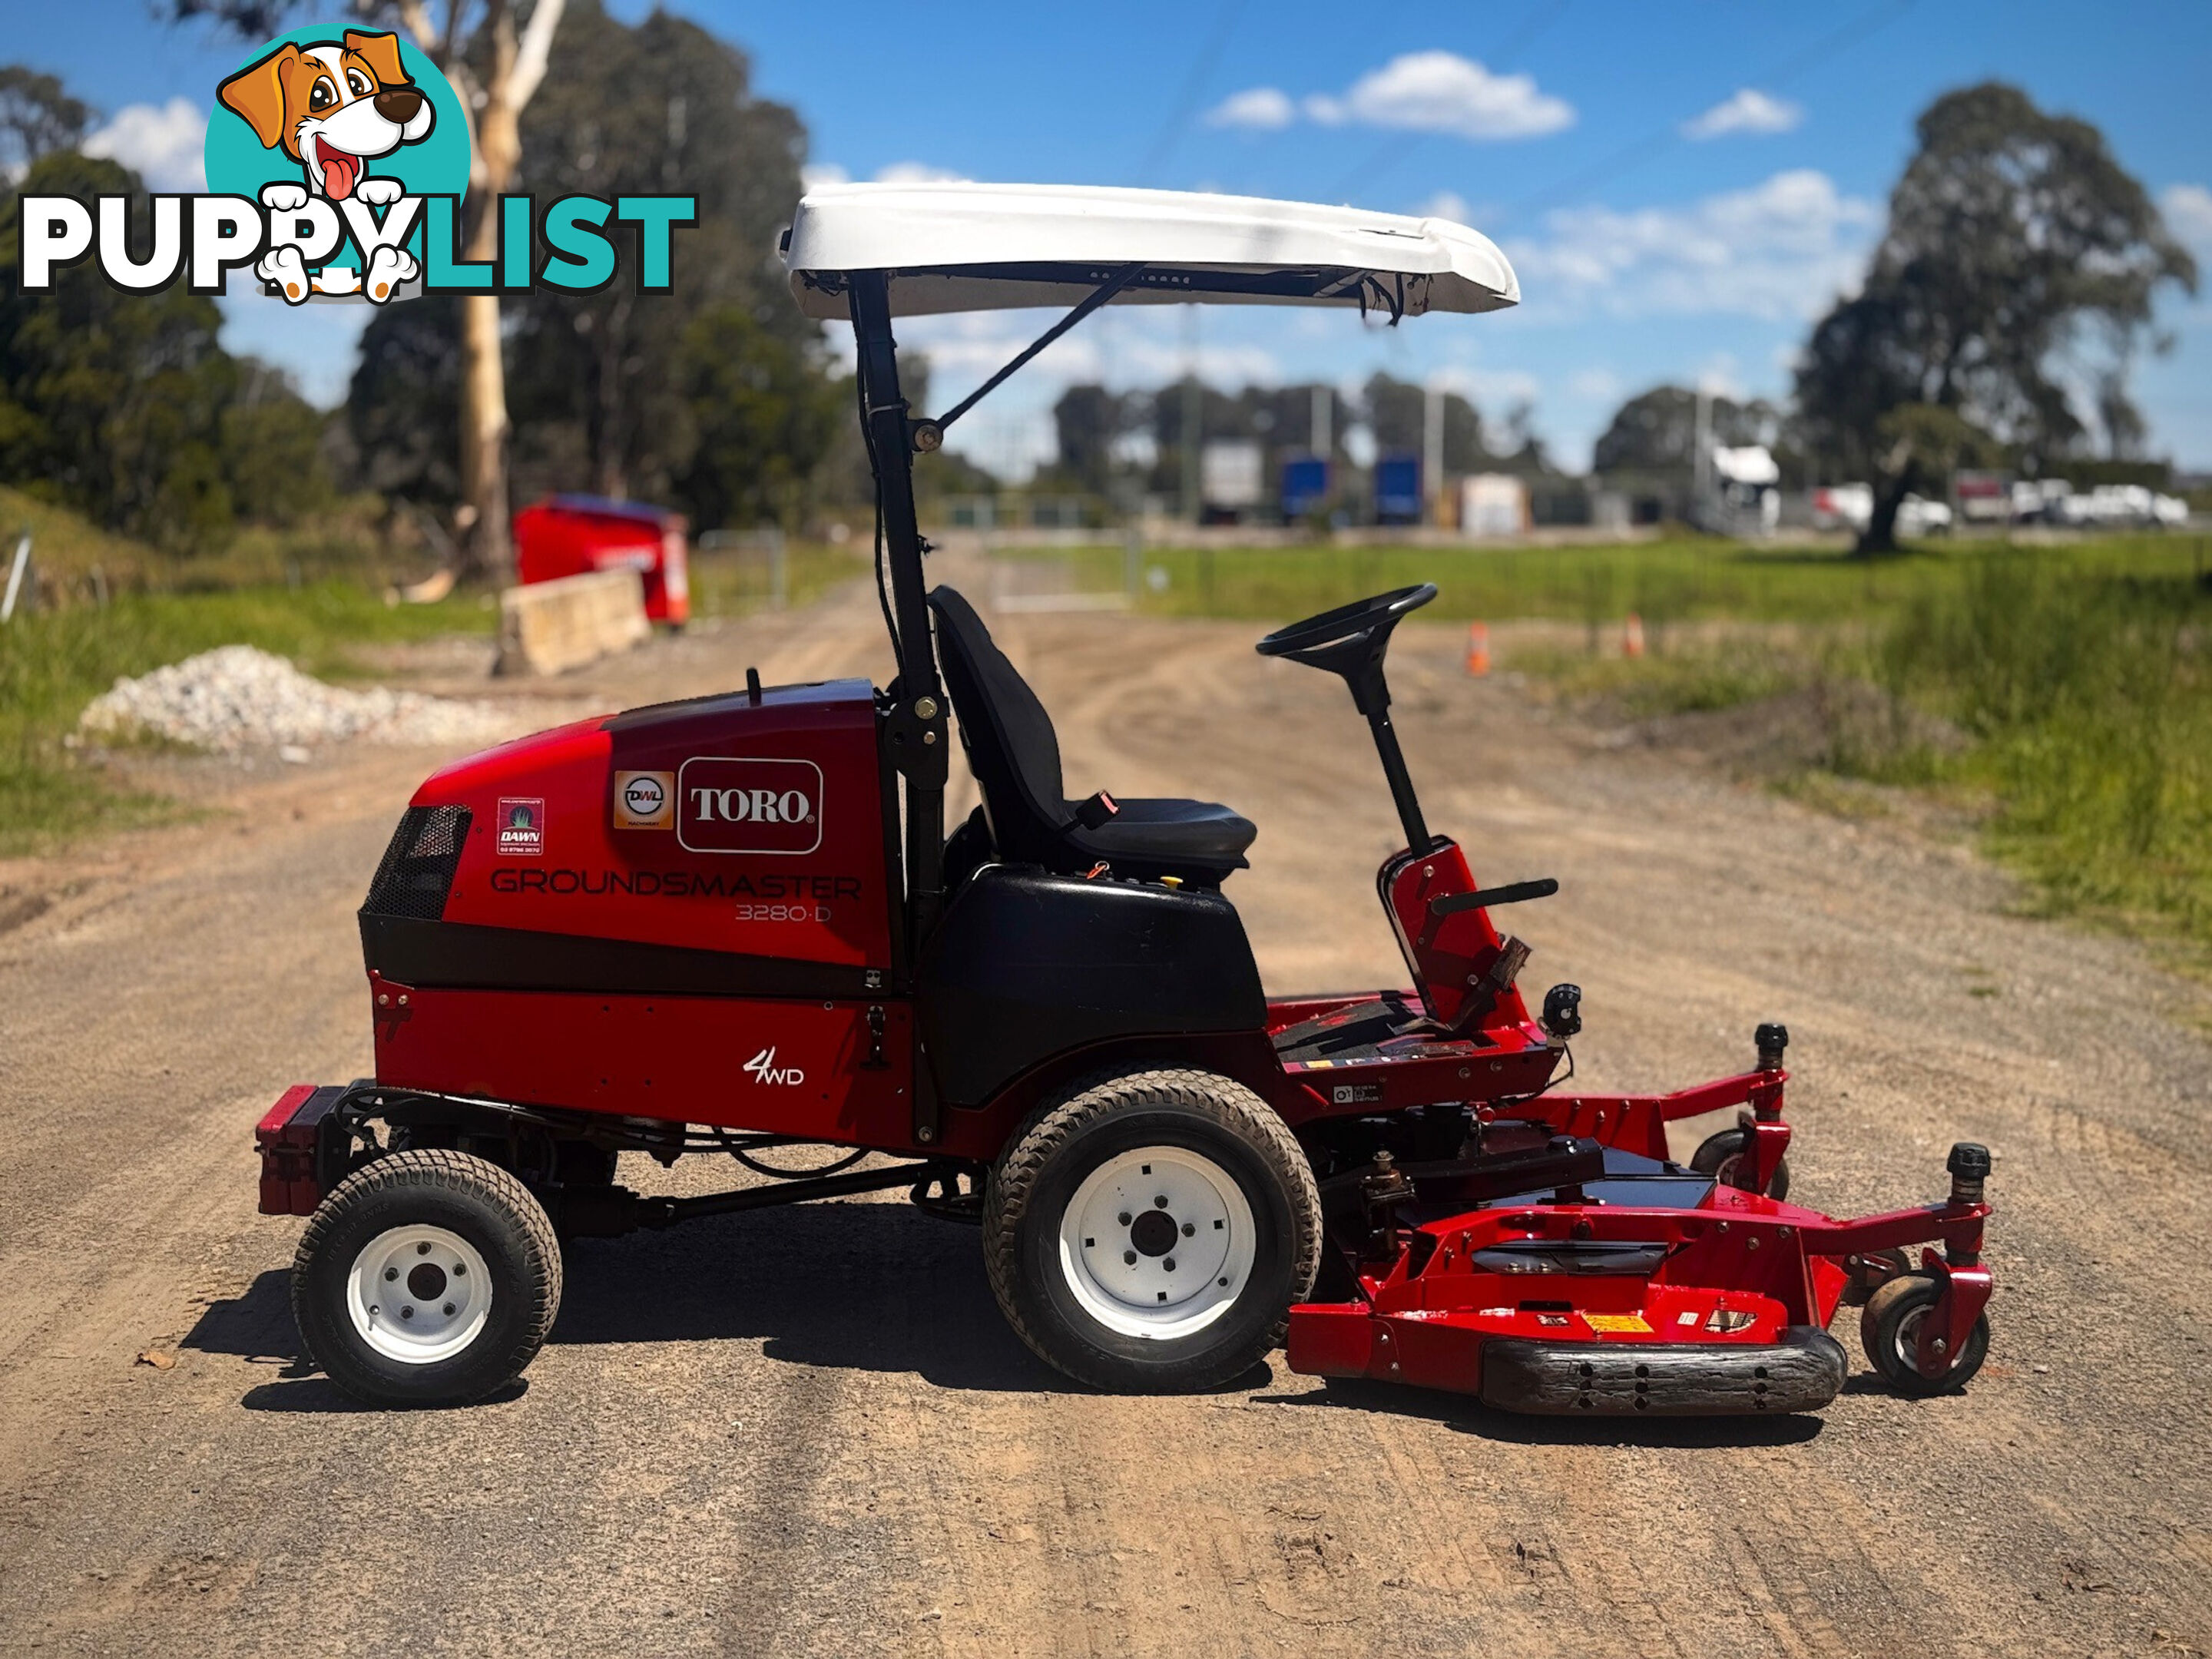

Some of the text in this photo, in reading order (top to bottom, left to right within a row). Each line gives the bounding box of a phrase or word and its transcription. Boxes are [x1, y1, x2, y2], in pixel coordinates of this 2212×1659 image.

[627, 790, 663, 801] DWL
[691, 788, 810, 823] TORO
[500, 831, 540, 842] DAWN
[490, 869, 862, 900] GROUNDSMASTER
[743, 1045, 804, 1085] 4WD
